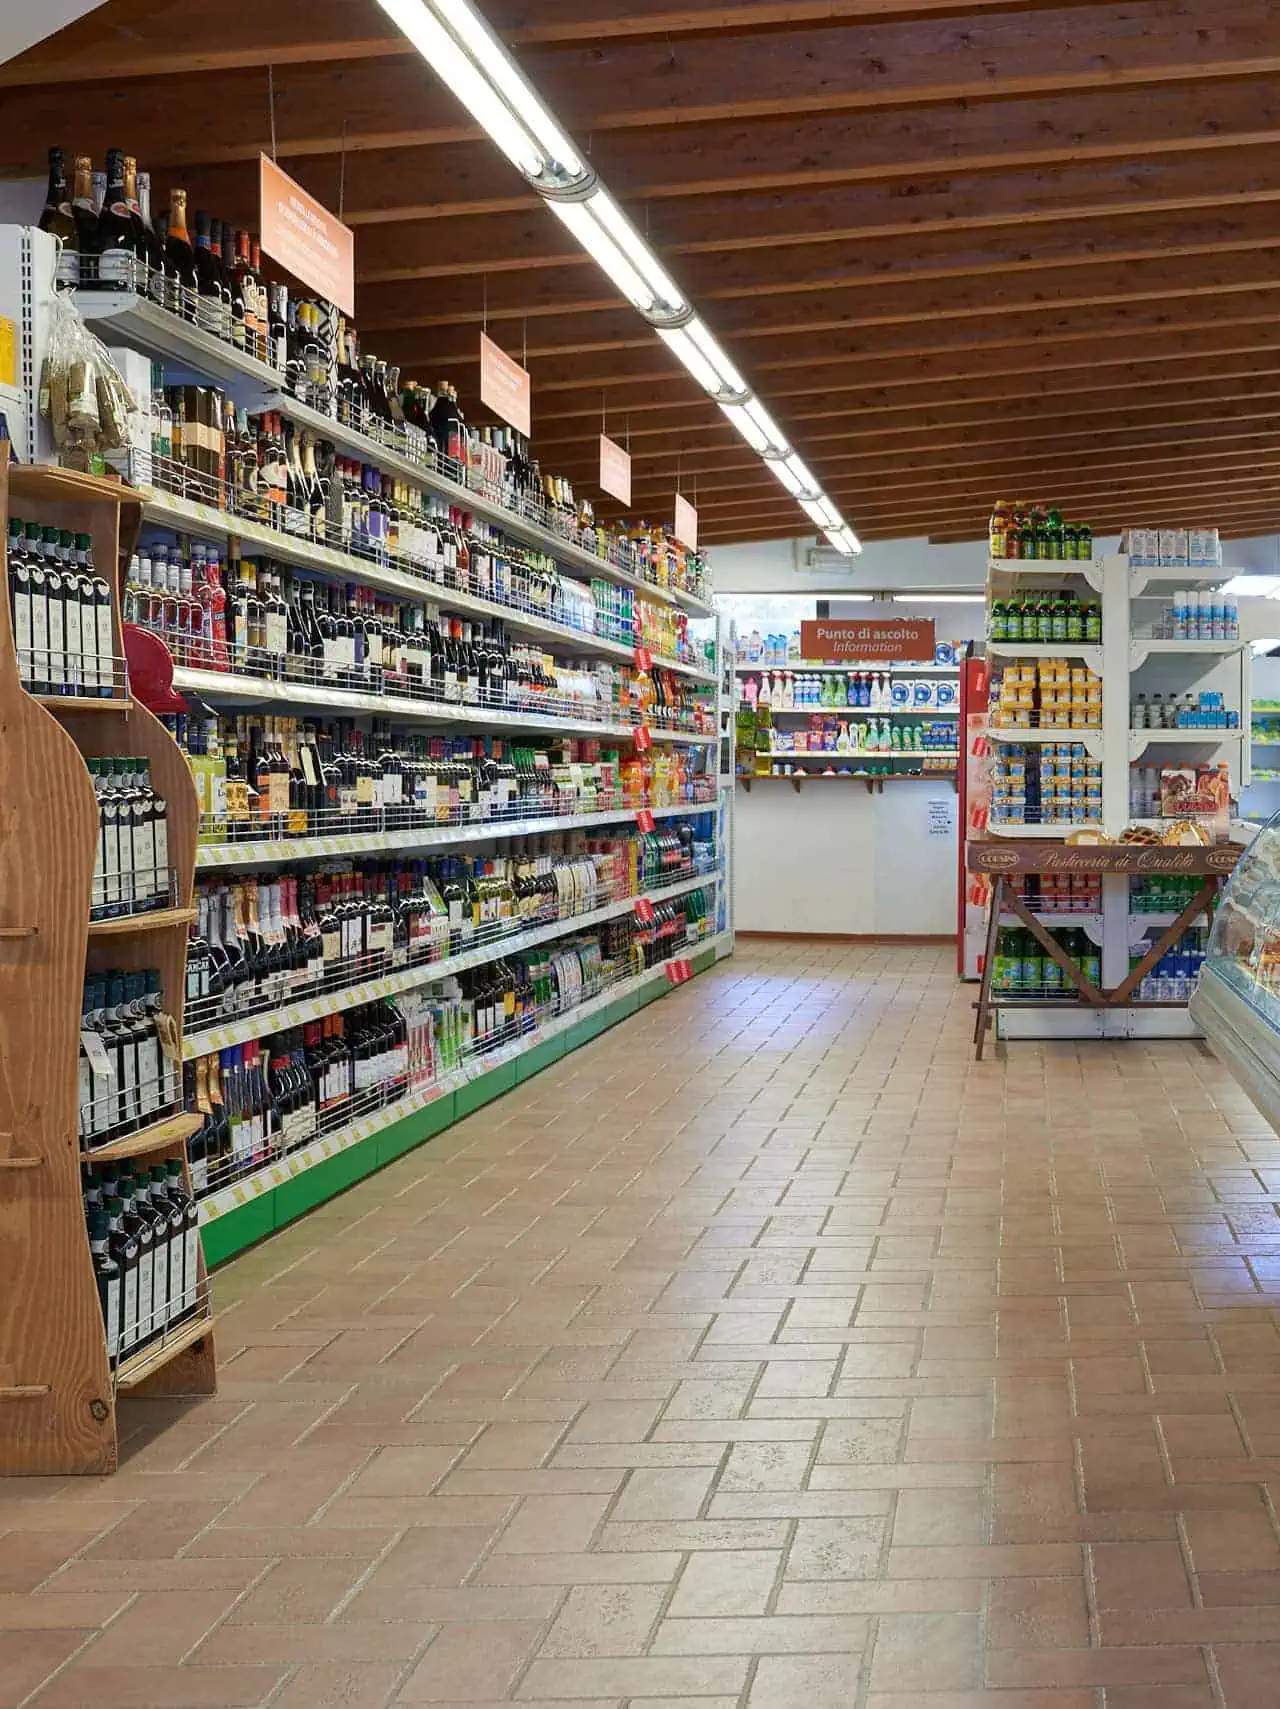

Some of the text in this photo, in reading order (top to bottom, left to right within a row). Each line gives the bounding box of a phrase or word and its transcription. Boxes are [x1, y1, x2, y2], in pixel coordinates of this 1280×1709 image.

[816, 628, 919, 640] Punto di ascolto
[833, 641, 902, 653] Information
[1033, 849, 1196, 869] Pasticceria di Qualità
